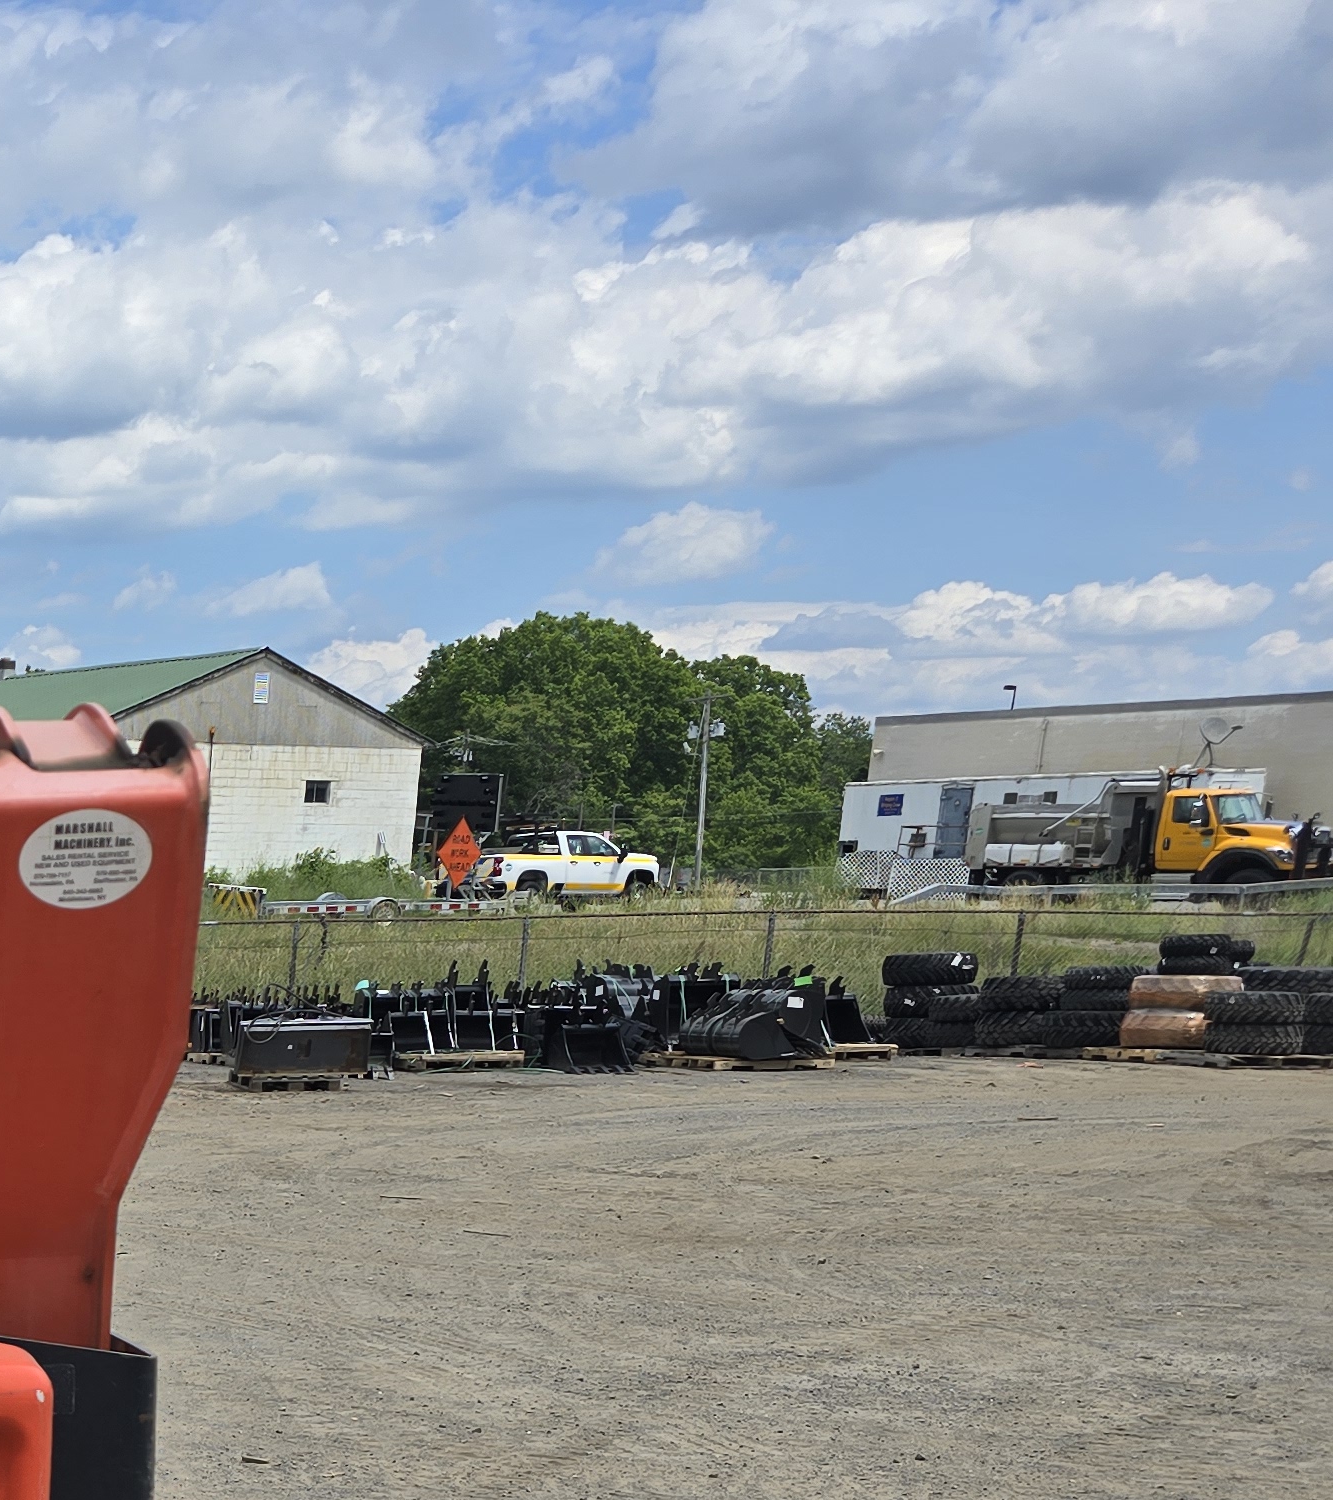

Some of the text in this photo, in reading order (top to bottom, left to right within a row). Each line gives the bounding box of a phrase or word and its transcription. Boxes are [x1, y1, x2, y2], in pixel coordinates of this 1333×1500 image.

[55, 821, 114, 835] MARSHALL
[453, 834, 471, 844] ROAD
[42, 850, 130, 861] SALES RENTAL SERVICE
[451, 849, 469, 857] WORK
[92, 858, 136, 866] EQUIPMENT
